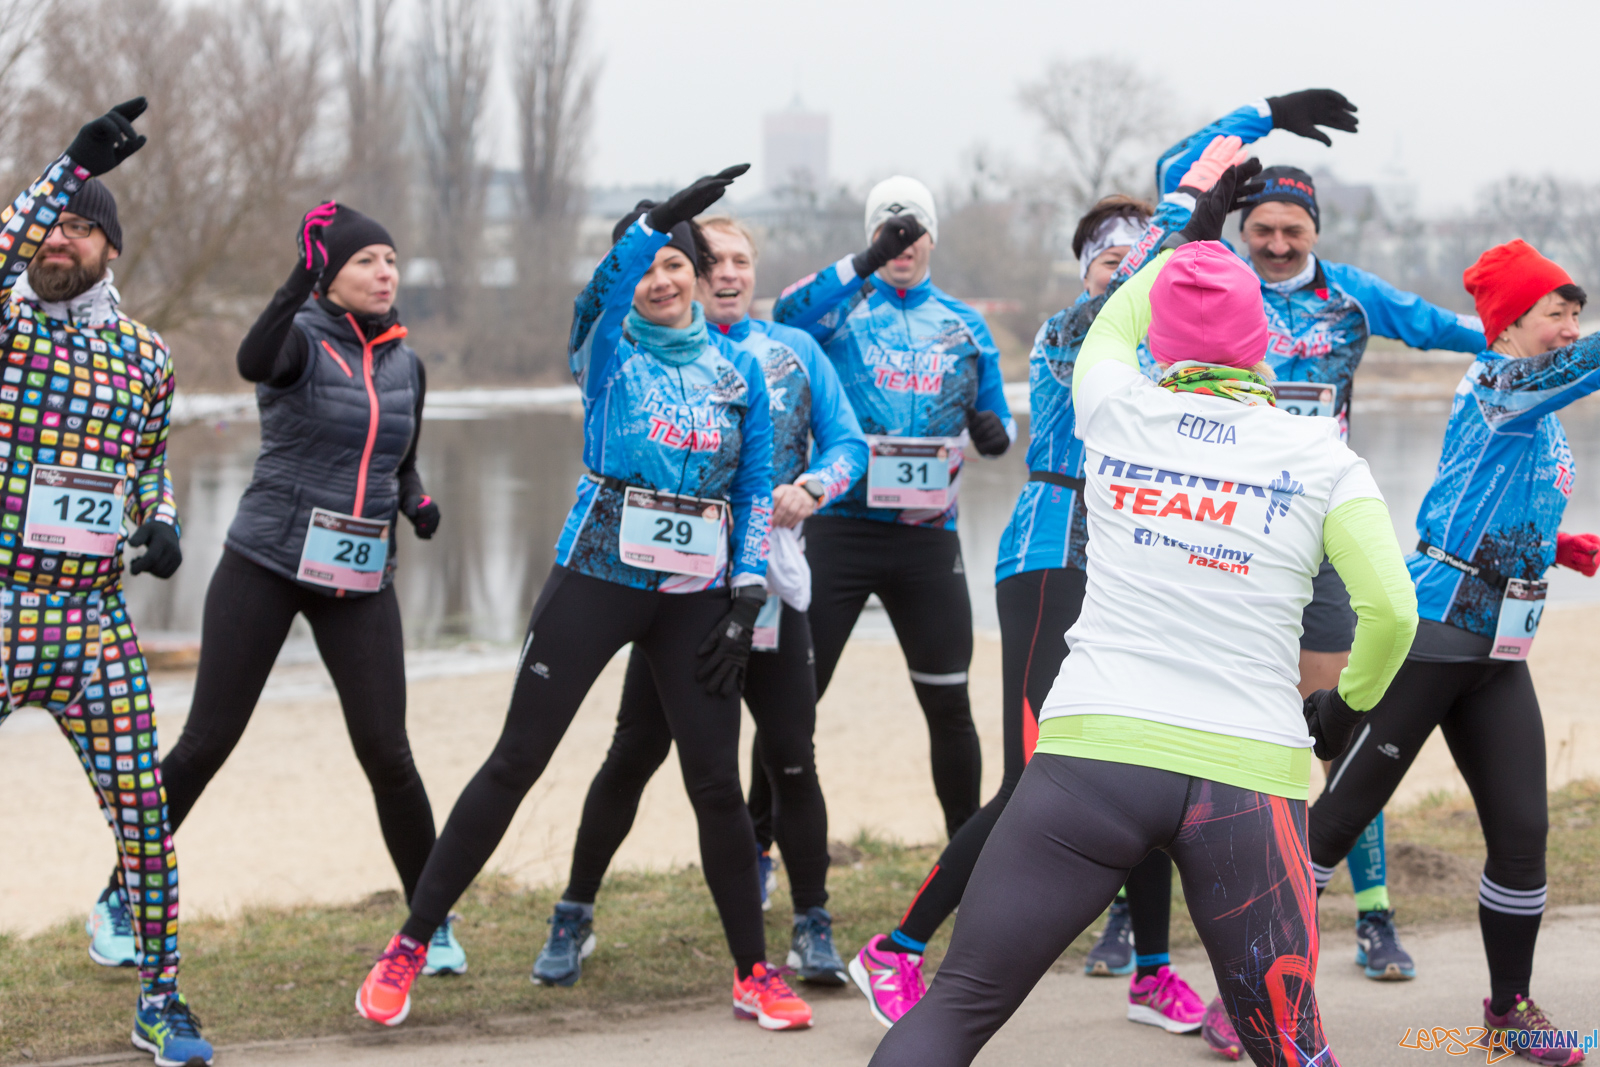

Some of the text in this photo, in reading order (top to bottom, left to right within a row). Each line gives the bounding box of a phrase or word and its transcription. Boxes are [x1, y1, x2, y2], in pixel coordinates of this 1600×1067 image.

[873, 368, 943, 394] TEAM
[647, 416, 722, 452] TEAM
[1176, 412, 1237, 445] EDZIA
[897, 462, 928, 484] 31
[53, 494, 112, 526] 122
[1109, 484, 1238, 526] TEAM
[652, 518, 692, 545] 29
[333, 540, 370, 565] 28
[1188, 554, 1250, 576] razem
[1361, 819, 1383, 881] kale
